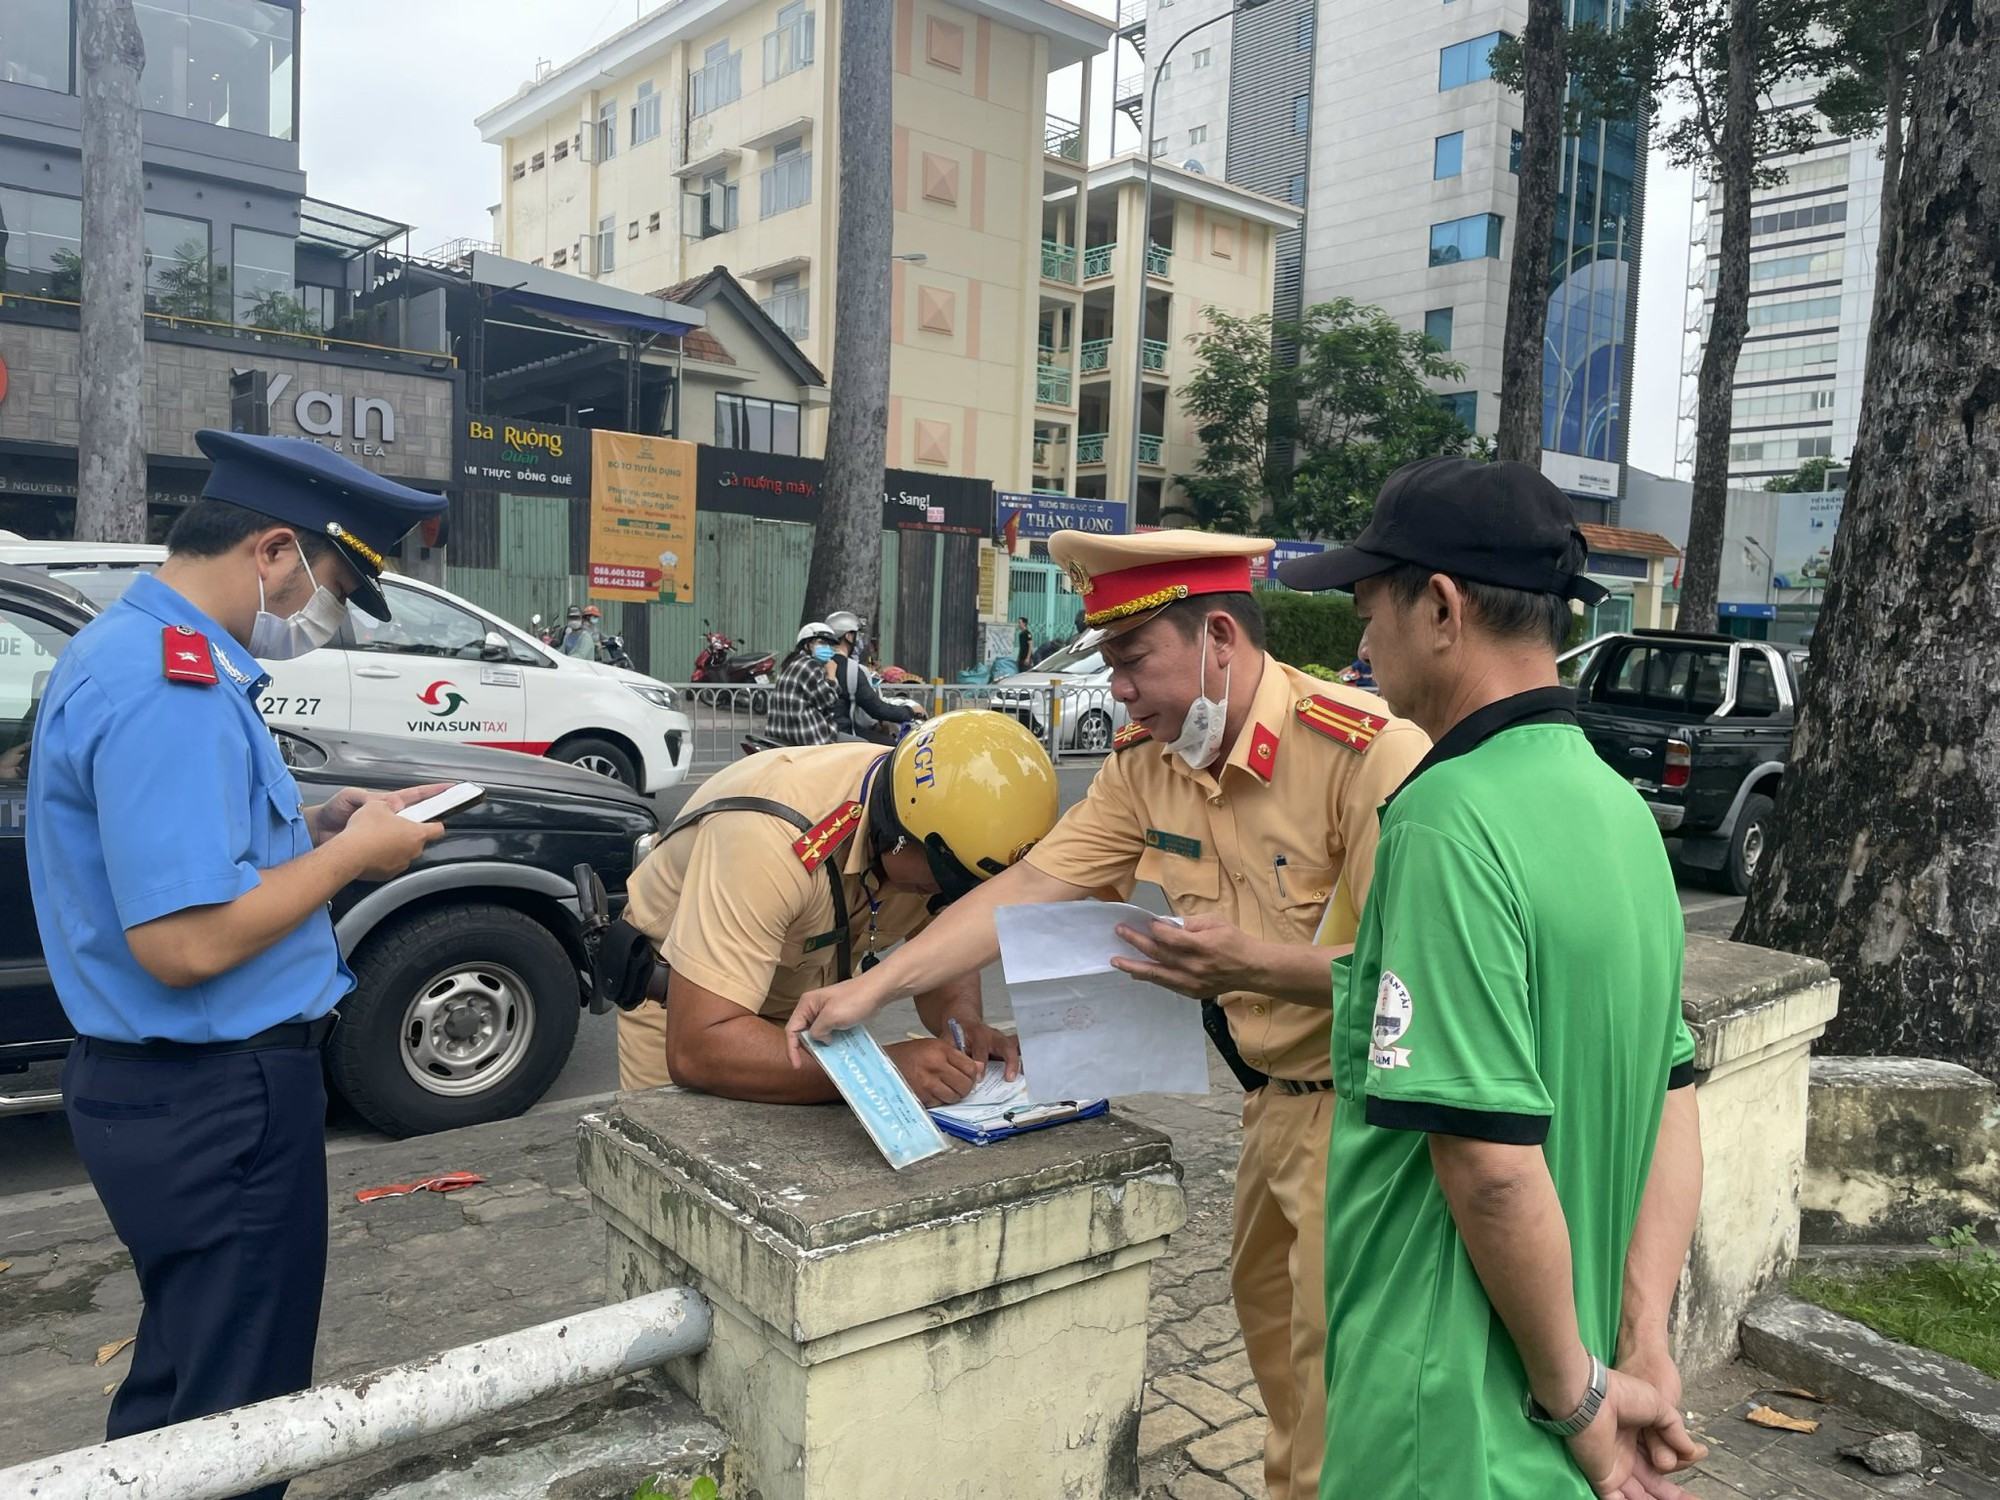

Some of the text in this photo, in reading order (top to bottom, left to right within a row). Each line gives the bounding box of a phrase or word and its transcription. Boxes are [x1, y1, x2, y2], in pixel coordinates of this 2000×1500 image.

[469, 421, 563, 457] Ba Ruộng
[333, 440, 343, 453] &
[351, 442, 386, 457] TEA
[482, 467, 511, 480] THỰC
[517, 468, 547, 482] ĐỒNG
[551, 474, 572, 485] QUÊ
[13, 482, 63, 493] NGUYEN
[899, 491, 930, 511] Sang!
[1026, 512, 1113, 532] THĂNG LONG
[262, 697, 321, 715] 27 27
